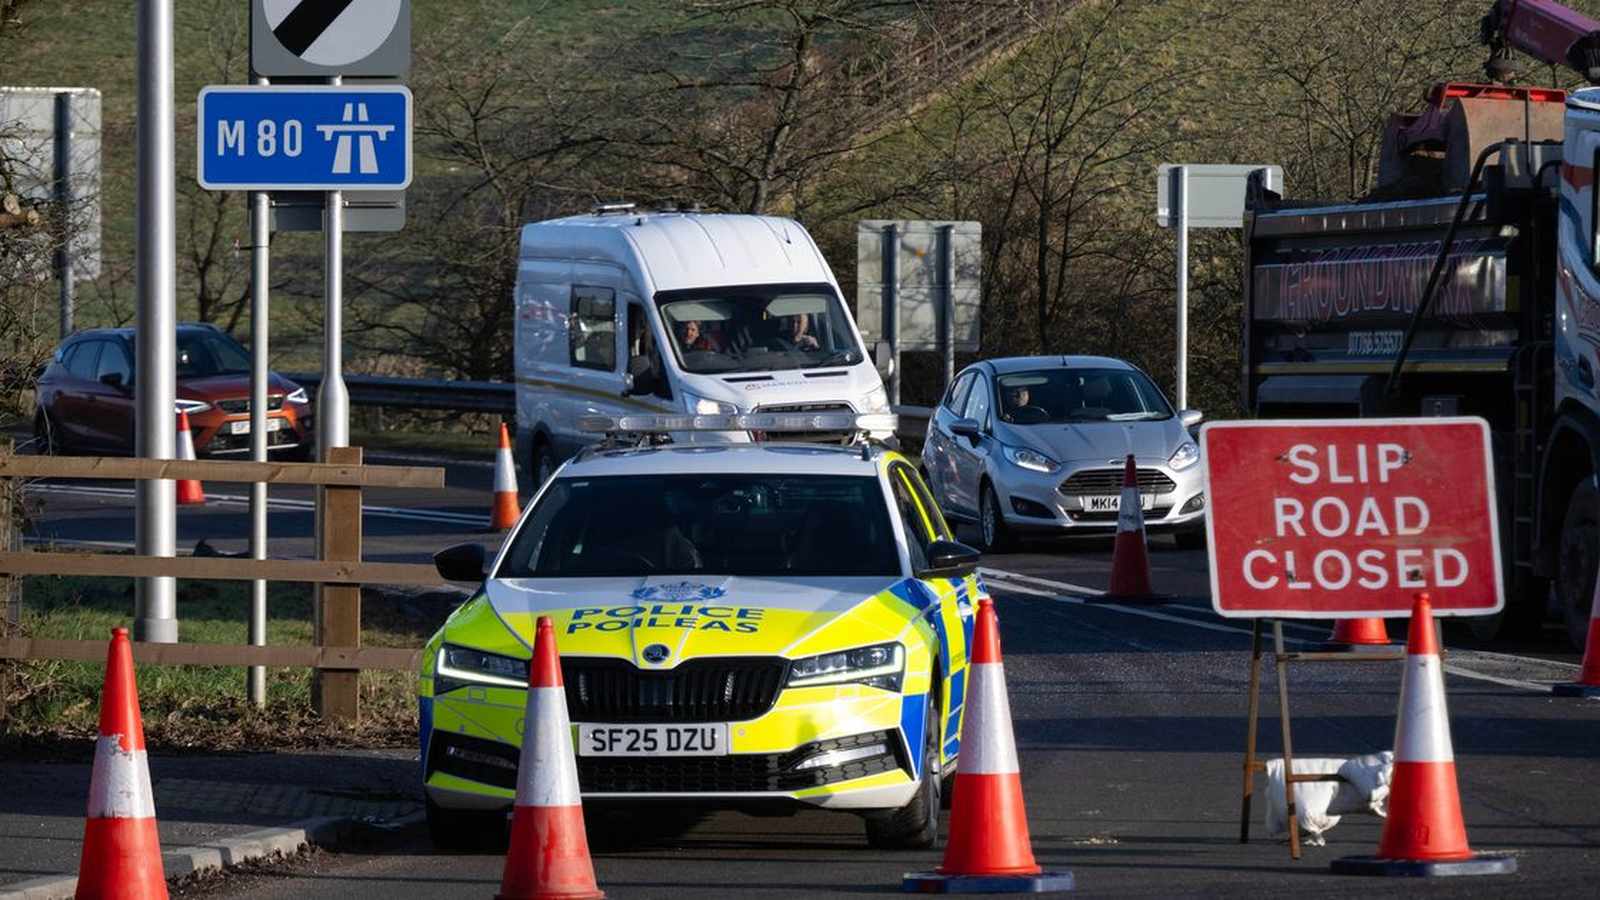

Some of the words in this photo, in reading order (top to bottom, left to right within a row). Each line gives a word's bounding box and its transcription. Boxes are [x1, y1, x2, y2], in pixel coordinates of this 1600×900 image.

[1288, 443, 1405, 484] SLIP
[1091, 497, 1119, 510] MK14
[1274, 496, 1430, 537] ROAD
[1243, 548, 1469, 590] CLOSED
[572, 604, 765, 621] POLICE
[566, 616, 759, 635] POILEAS
[591, 728, 659, 753] SF25
[665, 728, 716, 753] DZU
